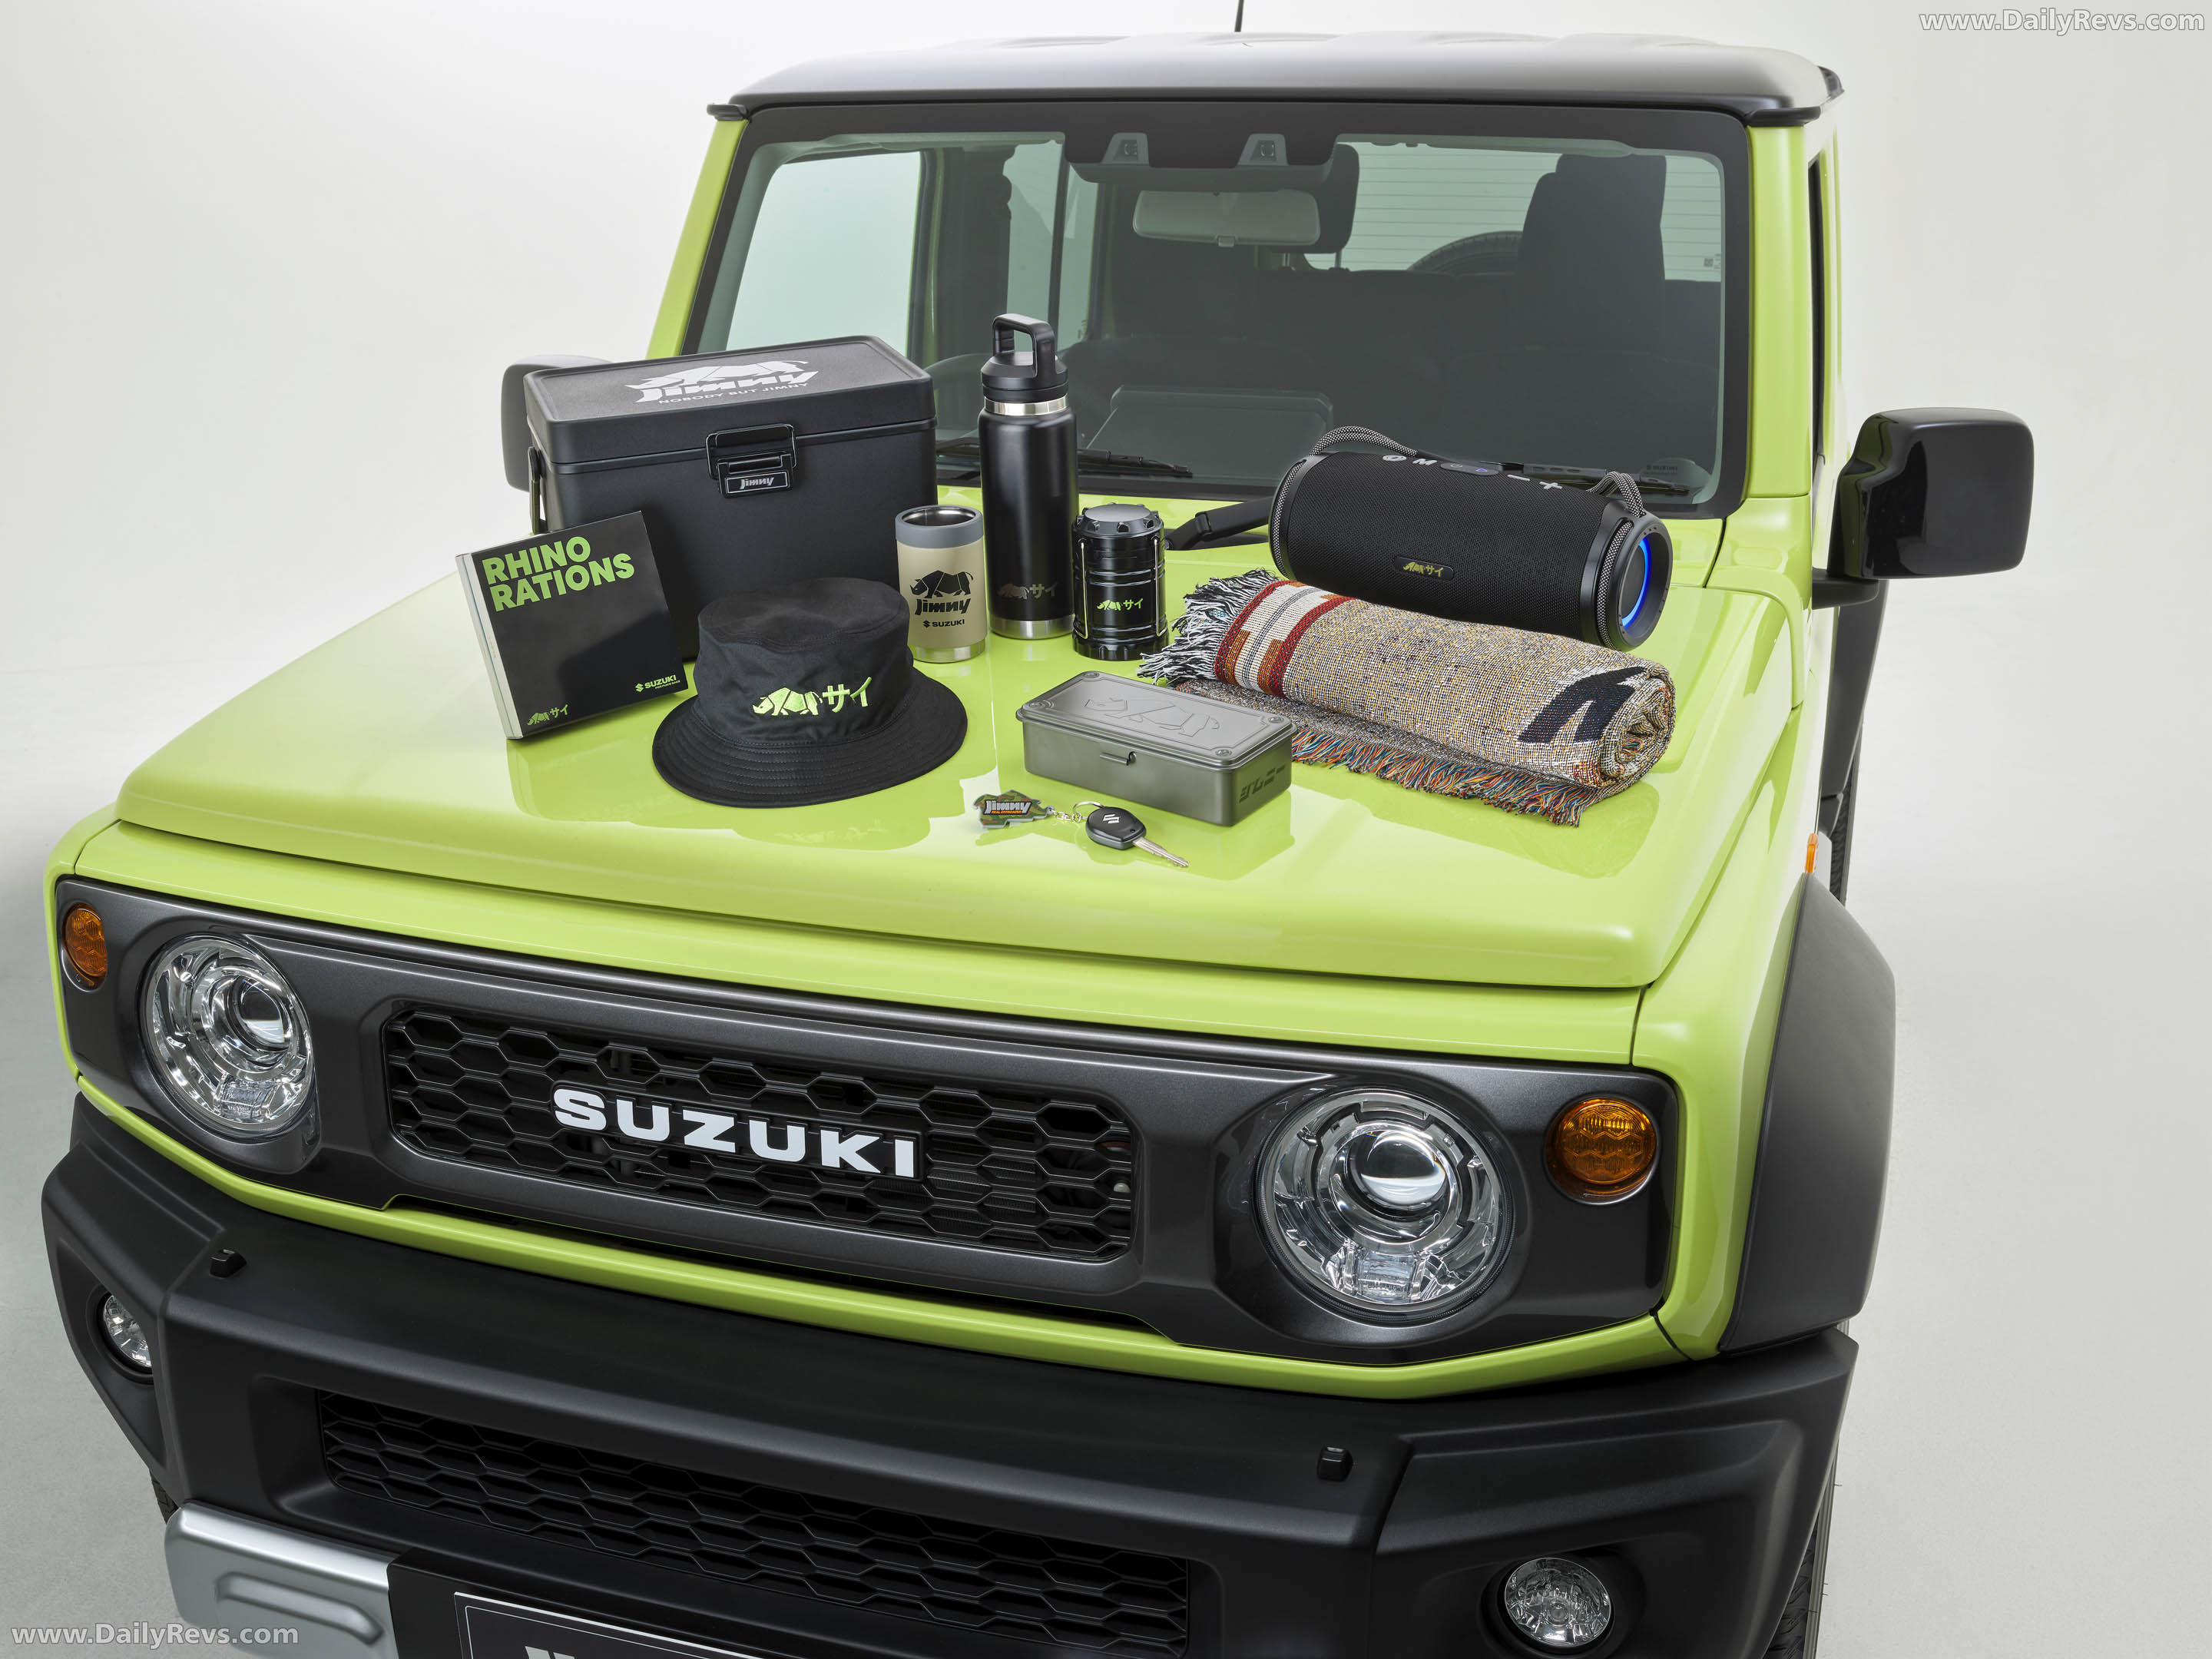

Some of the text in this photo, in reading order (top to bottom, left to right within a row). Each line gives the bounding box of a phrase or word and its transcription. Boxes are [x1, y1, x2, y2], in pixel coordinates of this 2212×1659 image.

[635, 371, 819, 403] Jimny
[658, 392, 724, 404] NOBODY
[763, 383, 809, 392] JIMNY
[740, 476, 775, 490] Jimny
[482, 536, 591, 585] RHINO
[1426, 565, 1444, 578] サイ
[489, 553, 635, 612] RATIONS
[915, 598, 971, 615] Jimny
[1123, 598, 1144, 611] サイ
[932, 619, 965, 628] SUZUKI
[644, 674, 677, 689] SUZUKI
[822, 677, 872, 713] サイ
[550, 704, 568, 718] サイ
[984, 800, 1031, 814] Jimny
[553, 1088, 915, 1177] SUZUKI
